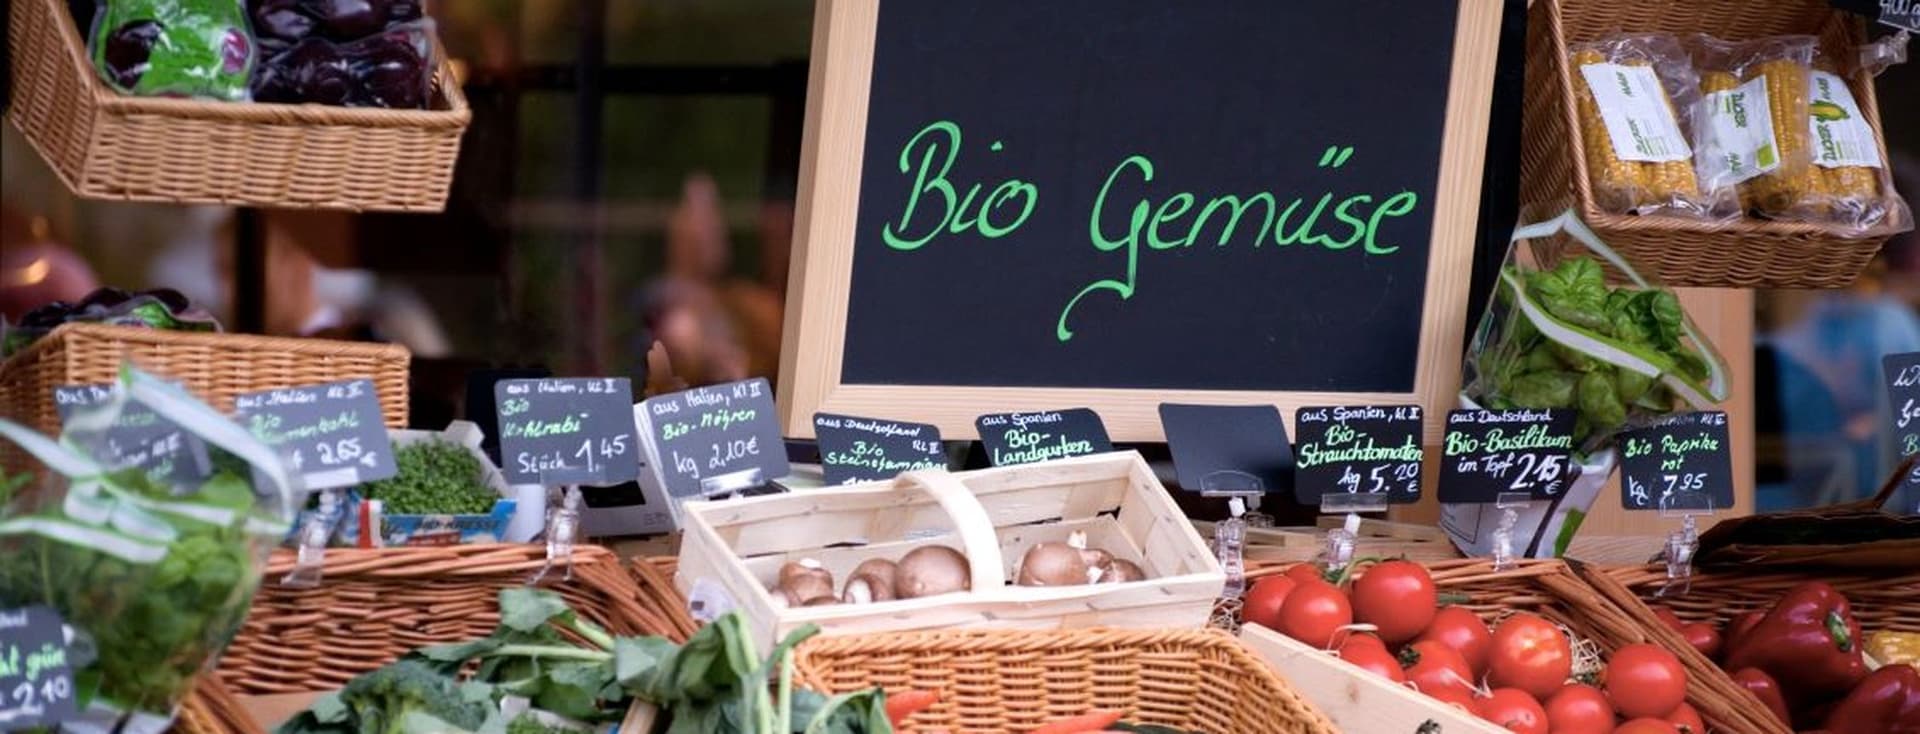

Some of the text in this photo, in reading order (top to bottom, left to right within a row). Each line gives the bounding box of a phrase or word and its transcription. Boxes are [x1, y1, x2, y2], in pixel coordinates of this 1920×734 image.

[1731, 91, 1748, 129] ZUCKER
[1815, 123, 1837, 162] ZUCKER
[882, 120, 1418, 342] Bio Gemüse
[653, 401, 680, 415] aus
[982, 410, 1063, 431] aus Spanien
[1301, 407, 1329, 423] aus
[1450, 407, 1554, 424] aus Deutschland
[816, 417, 841, 429] aus
[850, 440, 884, 457] Bio
[1004, 428, 1051, 449] Bio-
[1296, 434, 1424, 469] Strauchtomaten
[1445, 423, 1573, 456] Bio-Basilikum
[1624, 432, 1720, 458] Bio Paprika
[672, 450, 700, 480] kg
[1457, 456, 1478, 473] im
[1480, 451, 1517, 479] Topf
[1660, 453, 1685, 472] rot
[1337, 464, 1361, 494] kg
[1627, 474, 1649, 506] kg
